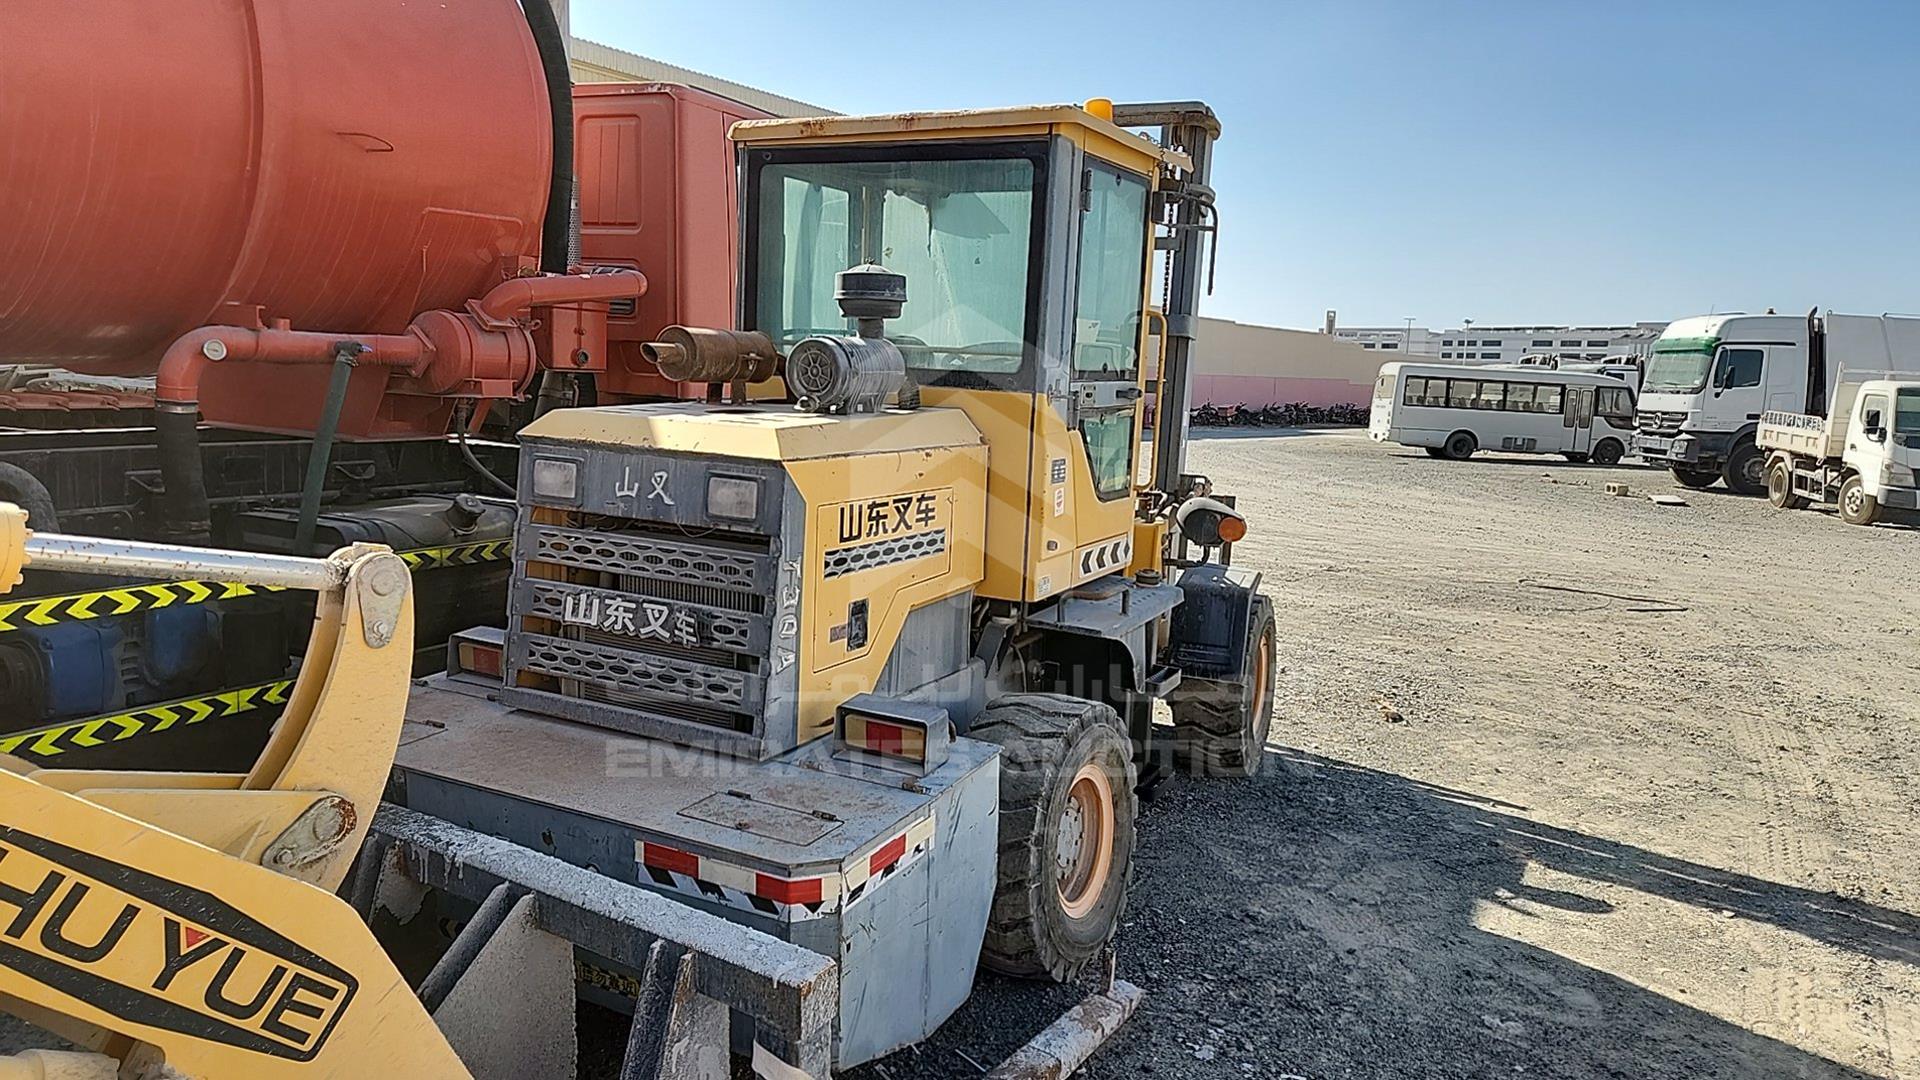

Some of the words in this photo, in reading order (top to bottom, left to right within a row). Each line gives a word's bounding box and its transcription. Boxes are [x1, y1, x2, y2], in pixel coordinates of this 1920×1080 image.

[615, 466, 675, 505] 山叉
[839, 493, 937, 543] 山东叉车
[564, 594, 698, 646] 山东叉车
